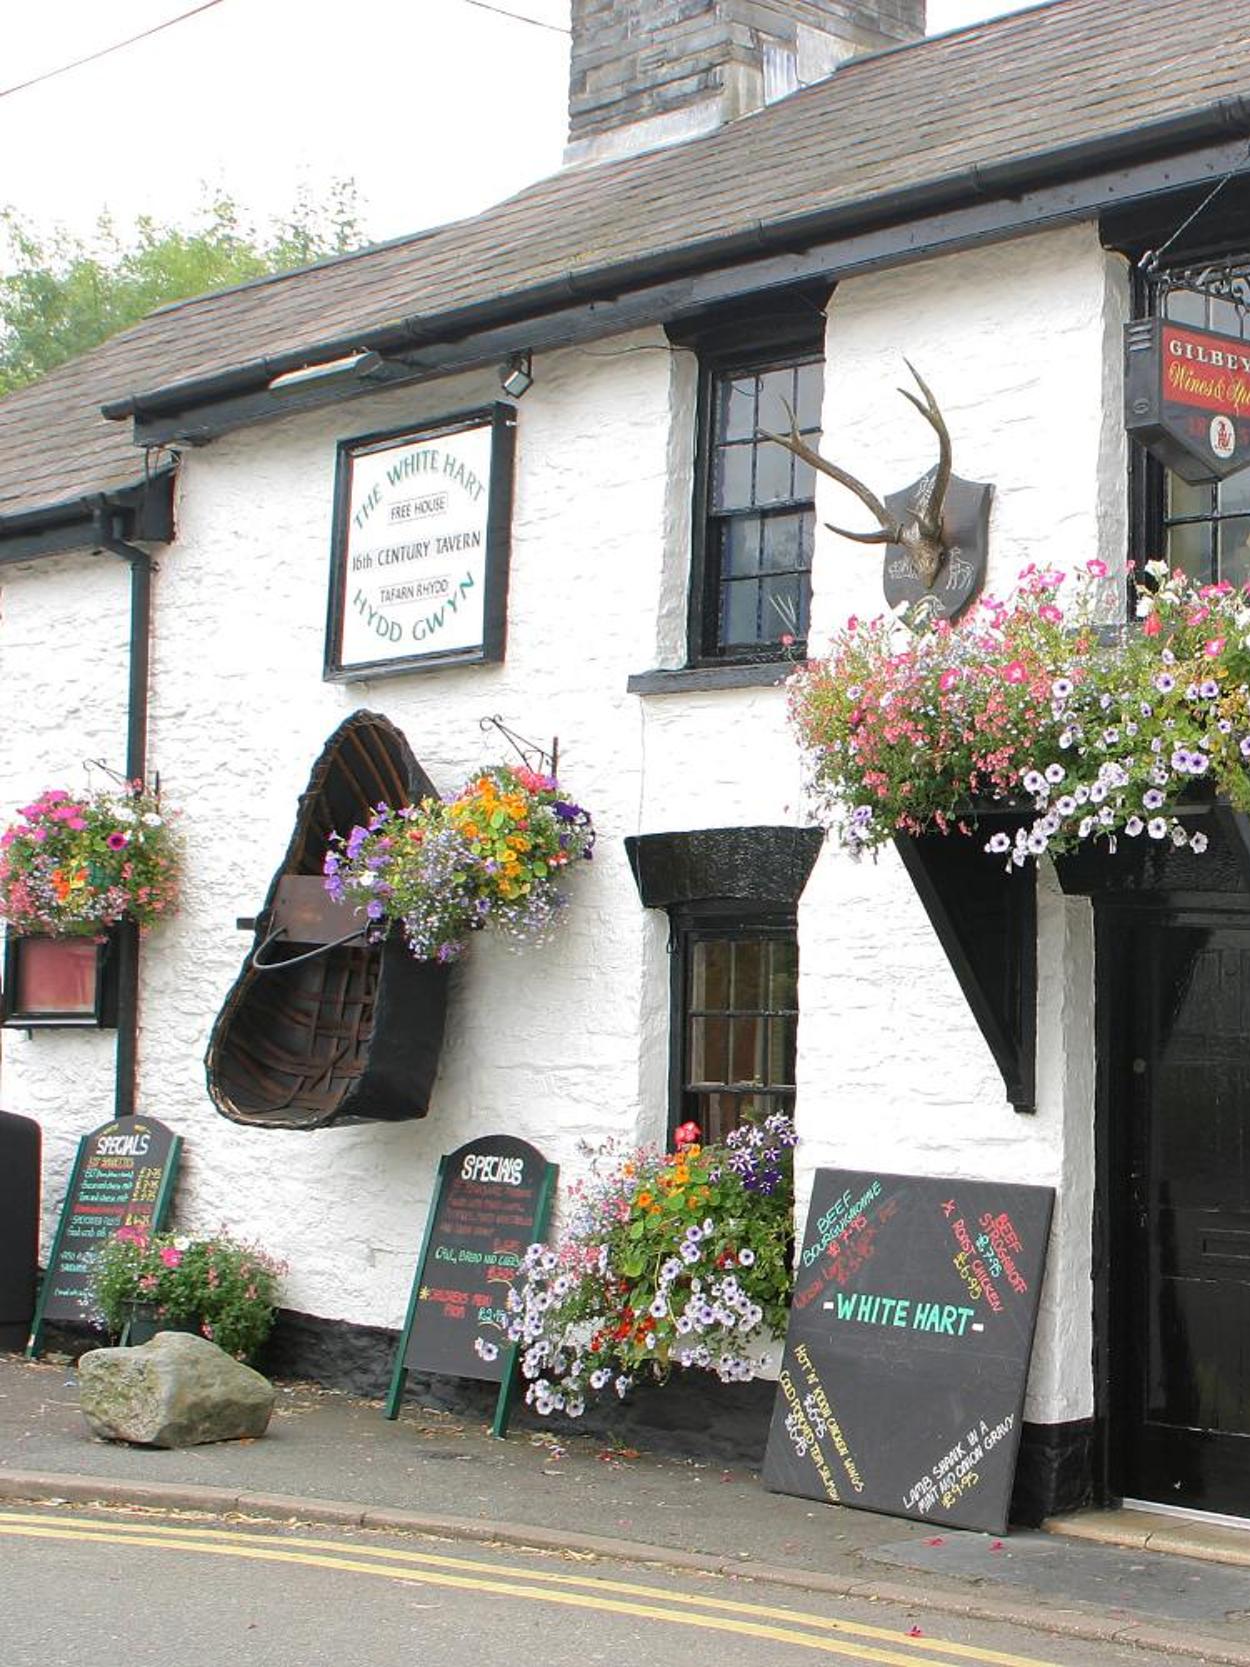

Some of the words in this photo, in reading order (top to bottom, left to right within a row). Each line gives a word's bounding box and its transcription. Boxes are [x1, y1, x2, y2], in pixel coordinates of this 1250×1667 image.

[1168, 361, 1212, 398] Wines
[353, 483, 383, 530] THE
[386, 449, 440, 487] WHITE
[443, 453, 486, 501] HART
[391, 504, 411, 520] FREE
[414, 496, 446, 516] HOUSE
[352, 556, 373, 572] 16th
[377, 541, 430, 567] CENTURY
[435, 530, 481, 555] TAVERN
[353, 589, 402, 642] HYDD
[412, 571, 475, 641] GWYN
[380, 584, 414, 603] TAFARN
[416, 578, 449, 598] RHYDD
[96, 1133, 150, 1155] SPECIALS
[461, 1154, 524, 1185] SPECIALS
[817, 1189, 852, 1234] BEEF
[995, 1212, 1023, 1253] BEEF
[952, 1219, 976, 1255] ROAST
[972, 1260, 1004, 1312] CHICKEN
[779, 1370, 796, 1401] COLD
[827, 1418, 848, 1456] CHICKEN
[844, 1458, 864, 1493] WINGS
[902, 1476, 932, 1509] LAMB
[933, 1441, 966, 1479] SHANK
[967, 1429, 979, 1446] IN
[979, 1420, 989, 1435] A
[918, 1485, 939, 1514] MINT
[984, 1413, 1014, 1449] GRAVY
